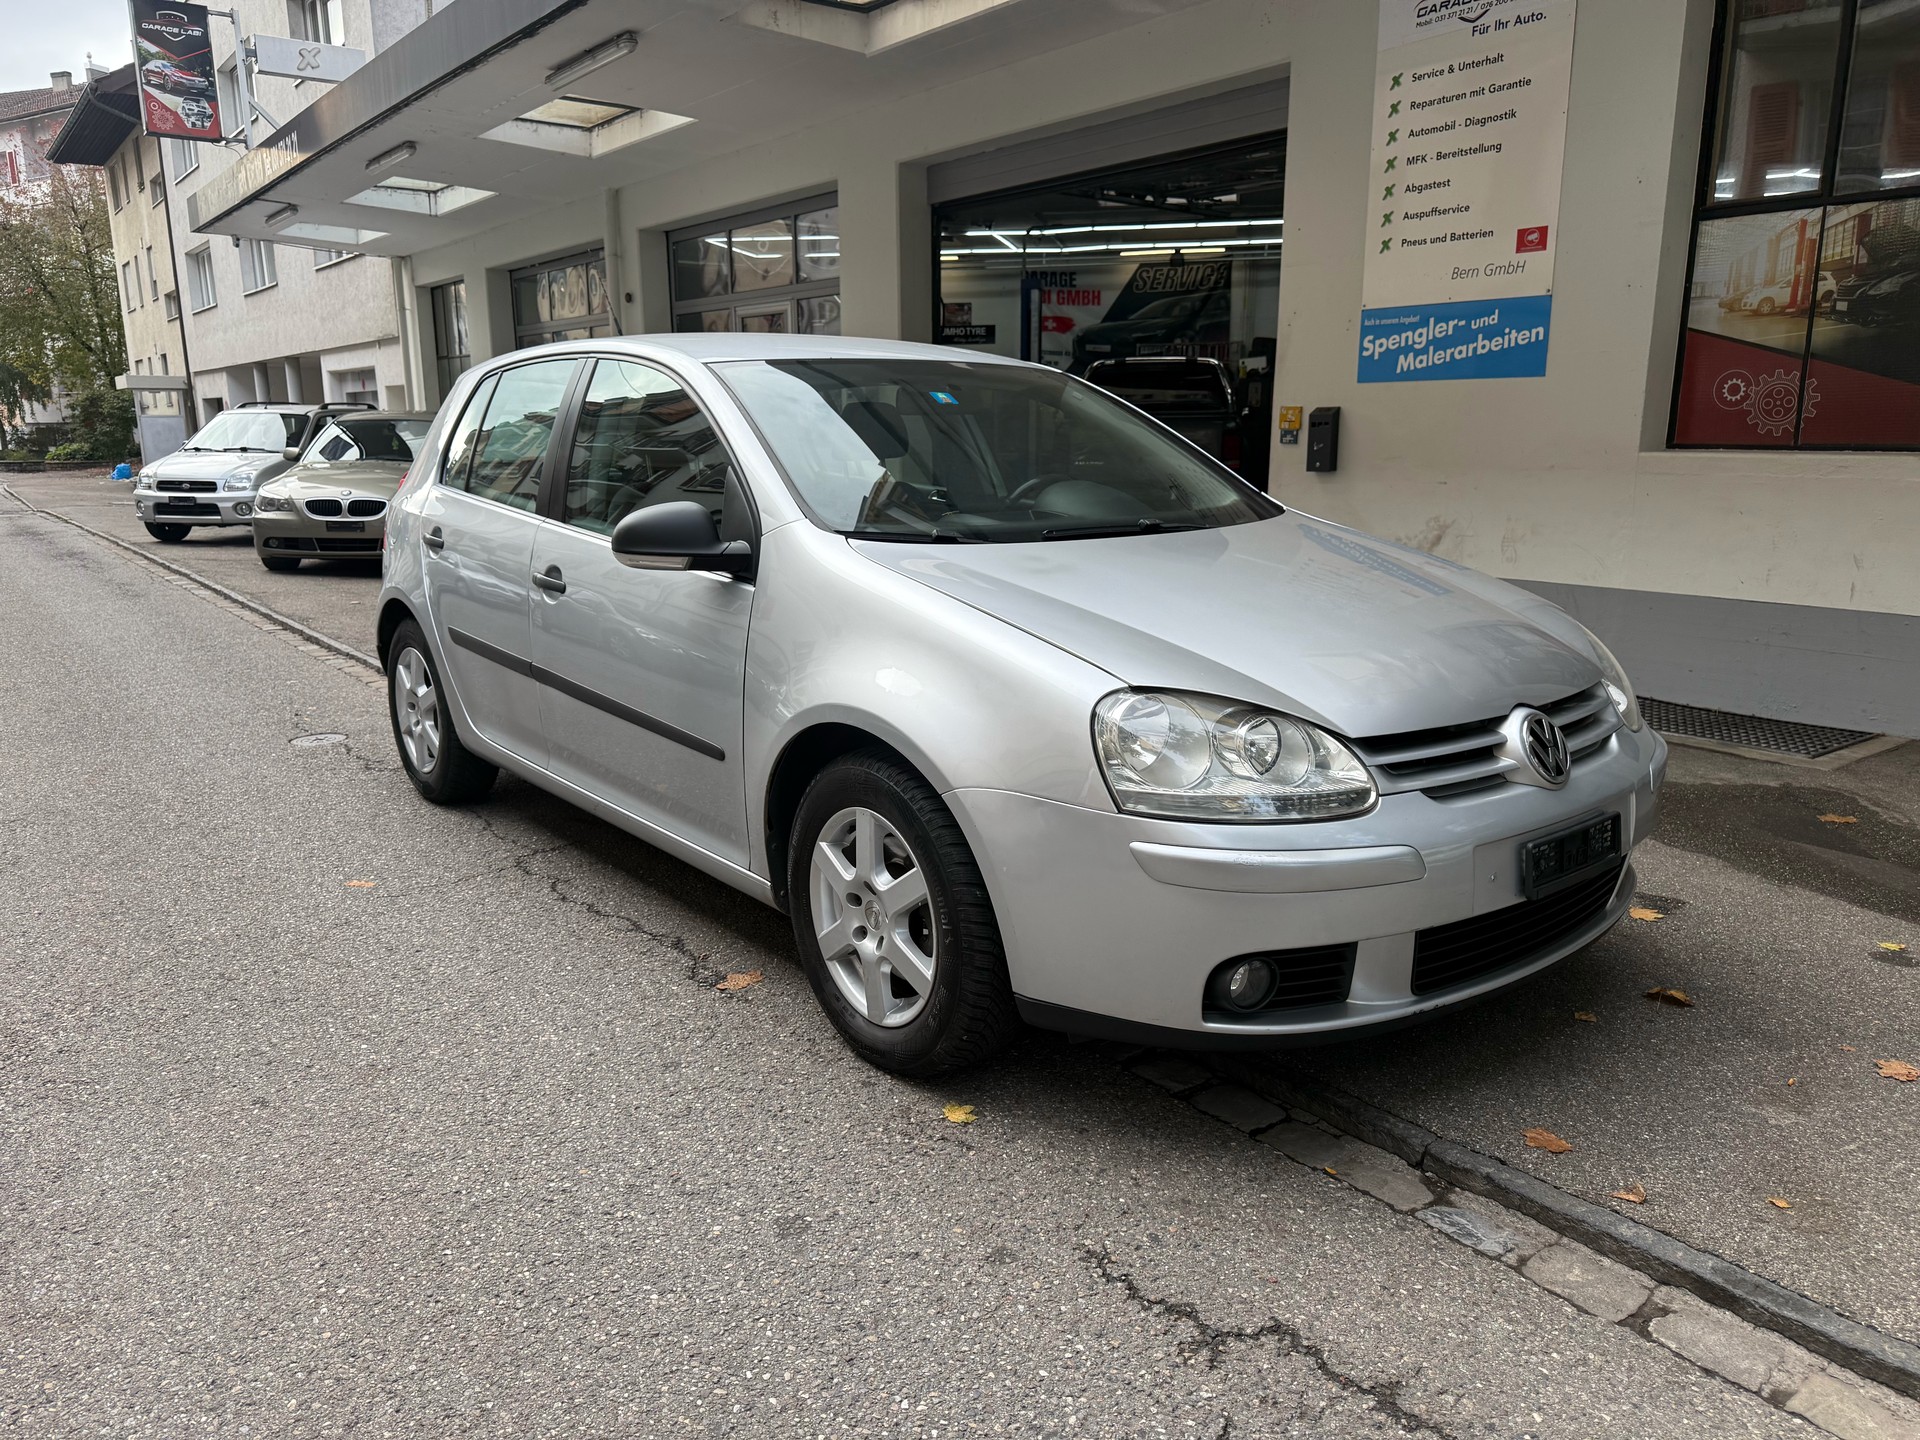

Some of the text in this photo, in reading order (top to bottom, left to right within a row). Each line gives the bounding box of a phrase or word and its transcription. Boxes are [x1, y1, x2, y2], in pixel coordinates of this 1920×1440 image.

[1434, 15, 1446, 23] 031
[1447, 12, 1458, 20] 371
[1472, 11, 1547, 37] Für Ihr Auto.
[142, 22, 202, 36] GARAGE LABI
[1412, 52, 1504, 83] Service & Unterhalt
[1410, 76, 1532, 111] Reparaturen mit Garantie
[1408, 120, 1456, 138] Automobil
[1464, 108, 1517, 128] Diagnostik
[1406, 154, 1428, 166] MFK
[1436, 142, 1502, 162] Bereitstellung
[1404, 178, 1451, 196] Abgastest
[1402, 203, 1470, 222] Auspuffservice
[1401, 228, 1494, 248] Pneus und Batterien
[1132, 262, 1228, 294] SERVICE
[1451, 260, 1527, 280] Bern GmbH
[1056, 288, 1102, 306] GMBH
[966, 327, 988, 336] TYRE
[1362, 309, 1499, 360] Spengler- und
[1396, 326, 1545, 374] Malerarbeiten
